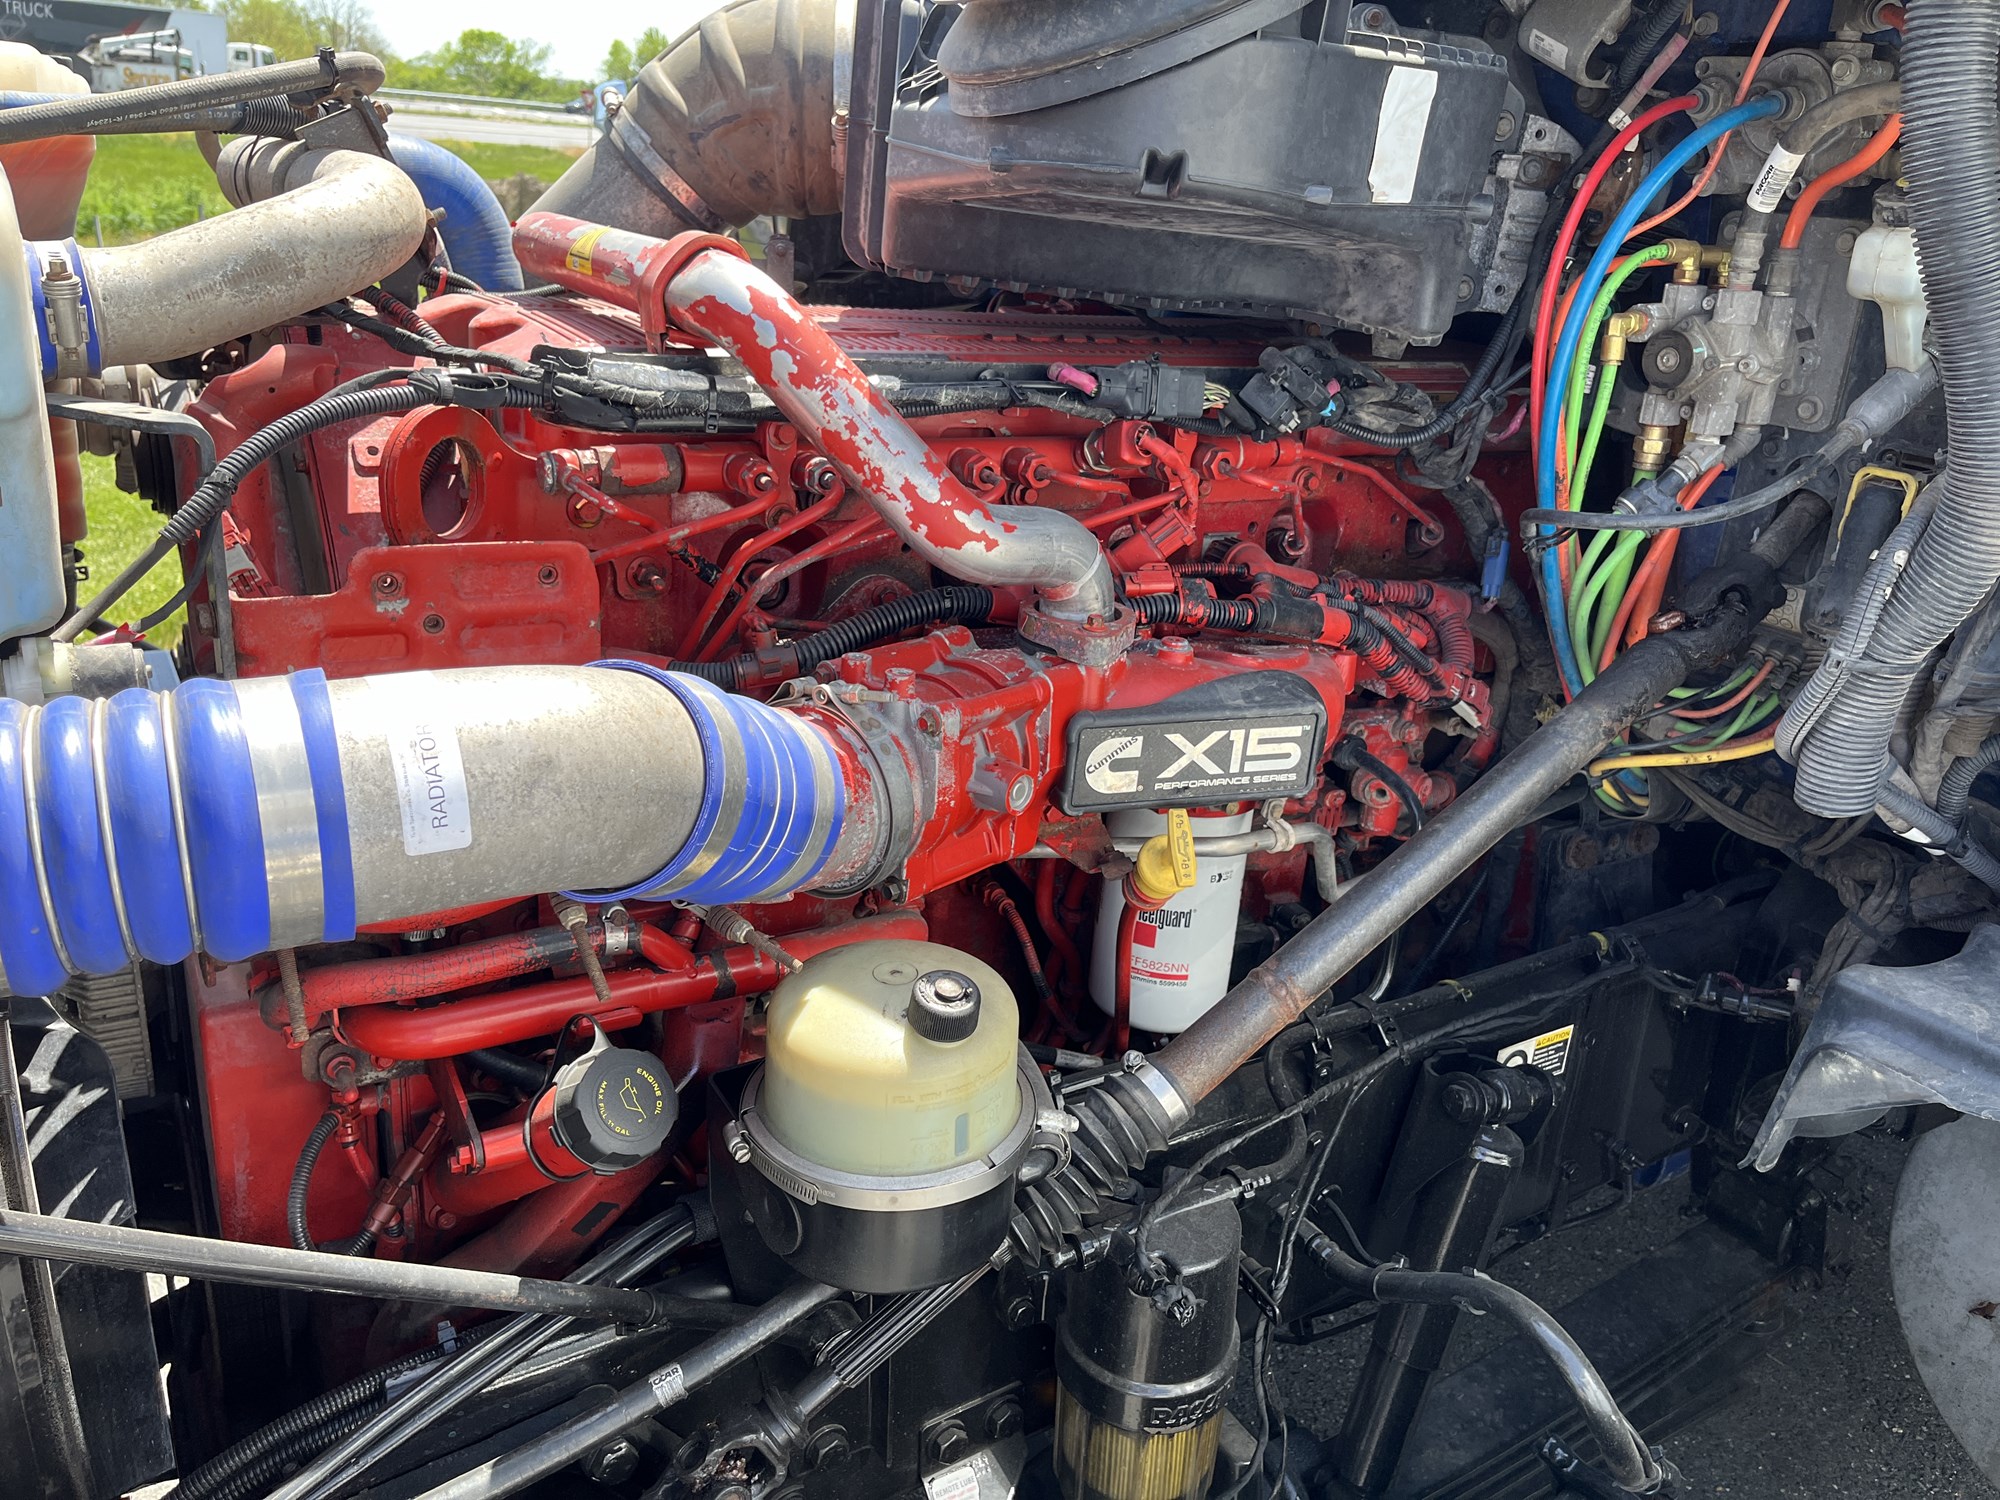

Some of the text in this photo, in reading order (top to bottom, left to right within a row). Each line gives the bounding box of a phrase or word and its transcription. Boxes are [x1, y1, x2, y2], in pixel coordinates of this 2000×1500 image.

[2, 1, 54, 19] TRUCK
[1755, 164, 1775, 196] PACCAR
[1086, 735, 1139, 775] Cummins
[1156, 725, 1303, 779] X15
[416, 724, 449, 829] RADIATOR
[1154, 777, 1250, 791] PERFORMANCE
[1252, 773, 1298, 784] SERIES
[1138, 908, 1193, 930] leetguard
[1130, 975, 1158, 985] ummins
[1541, 1031, 1571, 1045] CAUTION
[636, 1067, 663, 1115] ENGINE OIL
[598, 1080, 631, 1136] MAX FILL 11 GAL
[650, 1367, 679, 1386] CCAR
[935, 1483, 960, 1498] REMOTE
